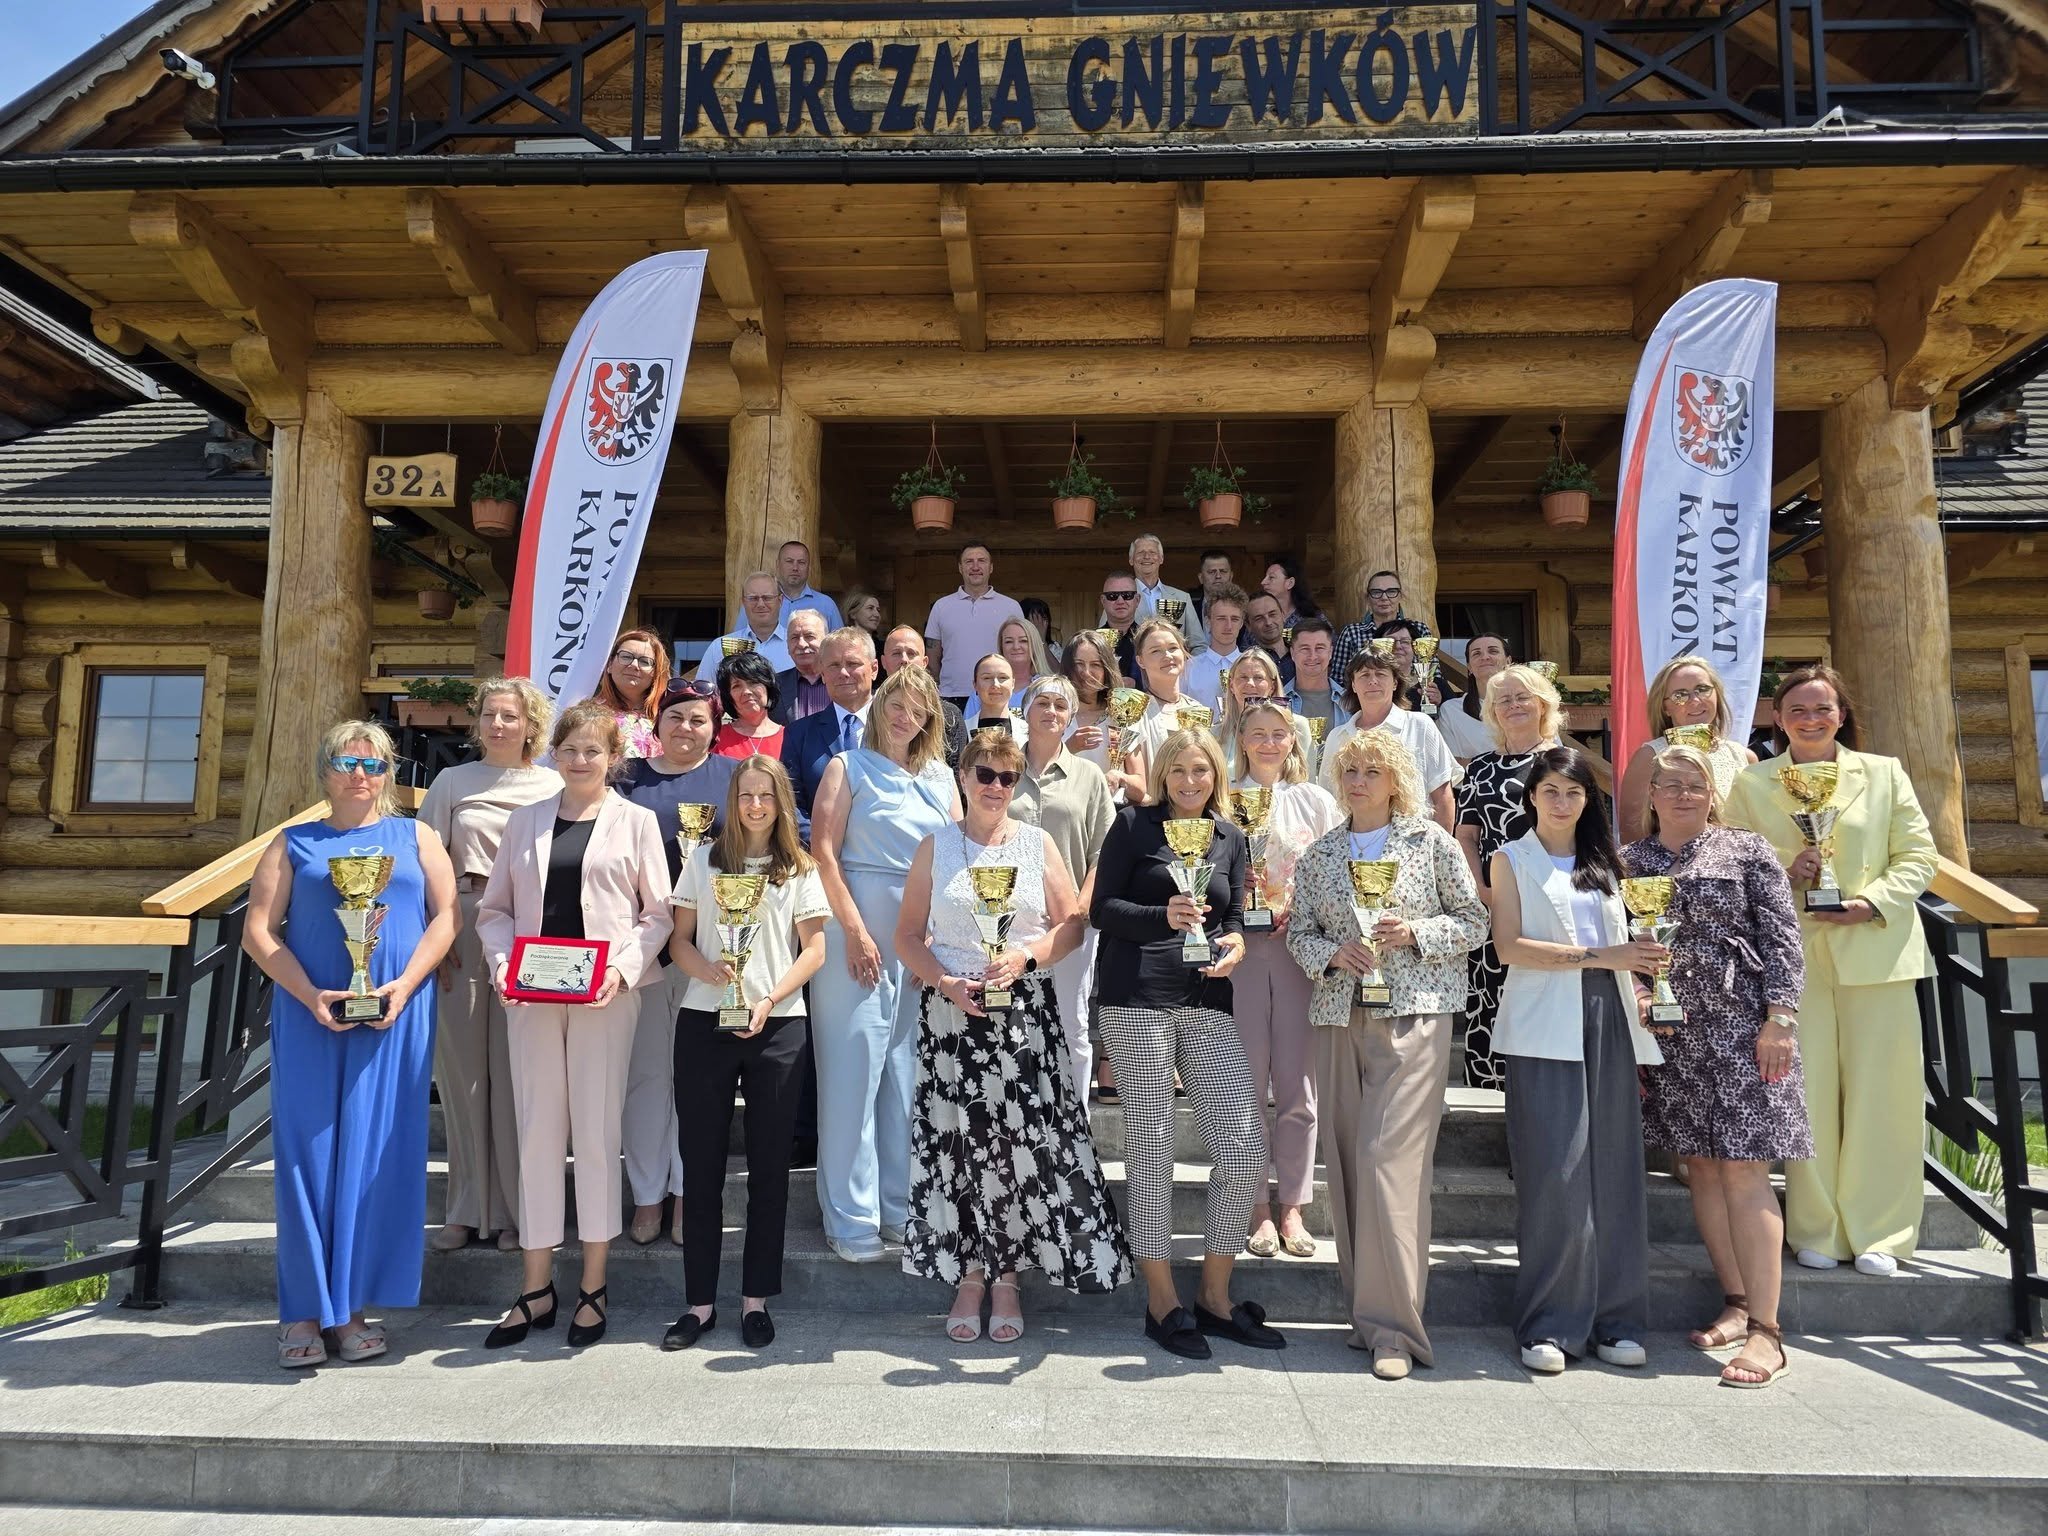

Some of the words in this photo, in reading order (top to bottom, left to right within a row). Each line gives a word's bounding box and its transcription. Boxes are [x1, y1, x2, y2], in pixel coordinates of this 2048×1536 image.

[682, 37, 1036, 137] KARCZMA
[1067, 9, 1478, 132] GNIEWKÓW
[547, 488, 602, 700] KARKONO
[1711, 500, 1740, 662] POWIAT
